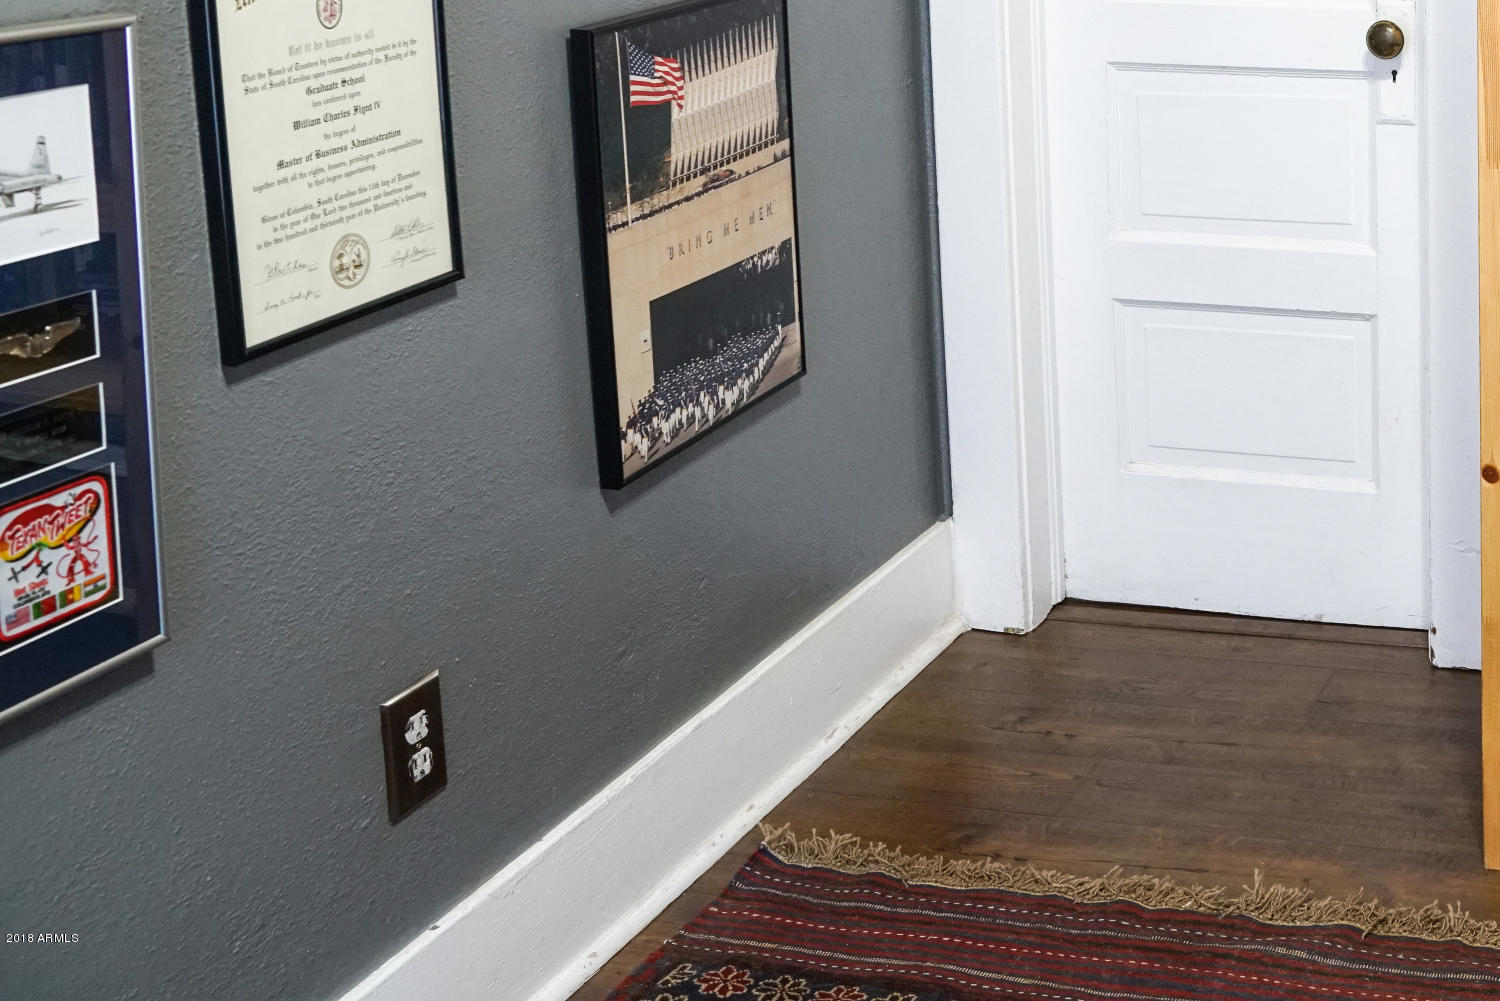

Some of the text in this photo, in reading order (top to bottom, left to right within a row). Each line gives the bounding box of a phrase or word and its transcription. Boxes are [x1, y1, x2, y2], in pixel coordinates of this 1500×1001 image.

[305, 73, 366, 97] Graduate School
[276, 127, 402, 171] Master of Business Administration
[668, 230, 713, 260] BRING
[722, 218, 741, 237] ME
